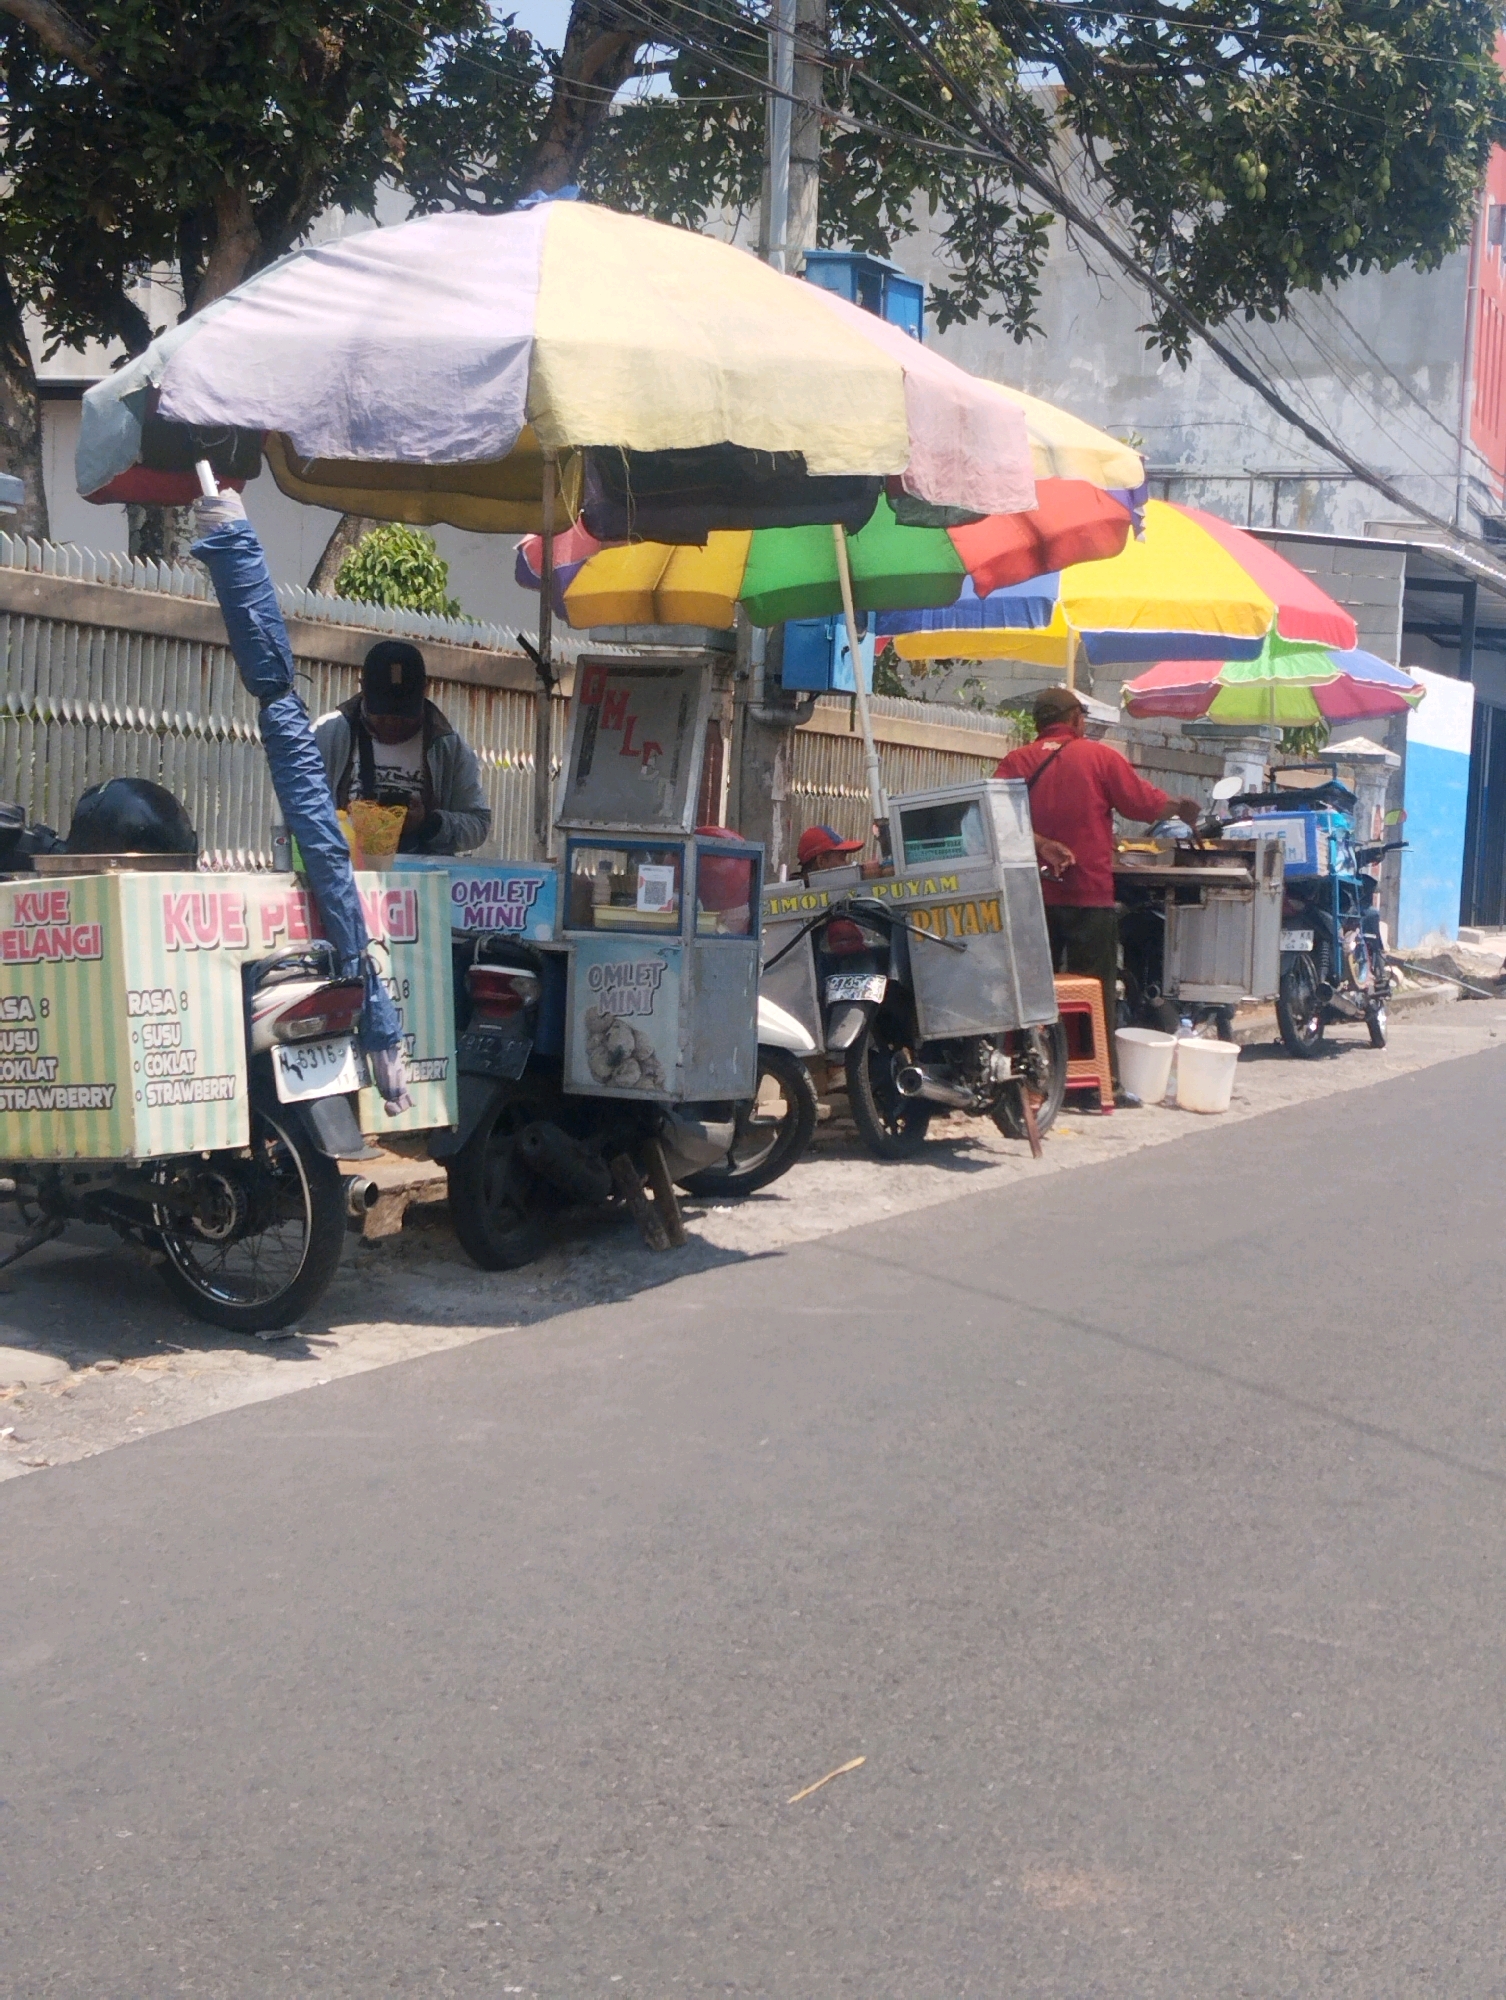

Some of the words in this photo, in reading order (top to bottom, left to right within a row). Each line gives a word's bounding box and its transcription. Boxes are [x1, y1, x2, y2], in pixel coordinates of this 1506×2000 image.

[450, 878, 545, 906] OMLET
[872, 874, 960, 899] PUYAM
[12, 889, 70, 926] KUE
[161, 890, 247, 952] KUE
[259, 889, 419, 948] PELNGI
[463, 904, 528, 931] MINI
[911, 900, 1004, 943] PUYAM
[0, 924, 103, 964] ELANGI
[587, 961, 668, 992] OMLET
[127, 988, 177, 1018] RASA
[599, 988, 654, 1018] MINI
[142, 1022, 182, 1050] SUSU
[143, 1049, 197, 1078] COKLAT
[145, 1074, 236, 1108] STRAWBERRY
